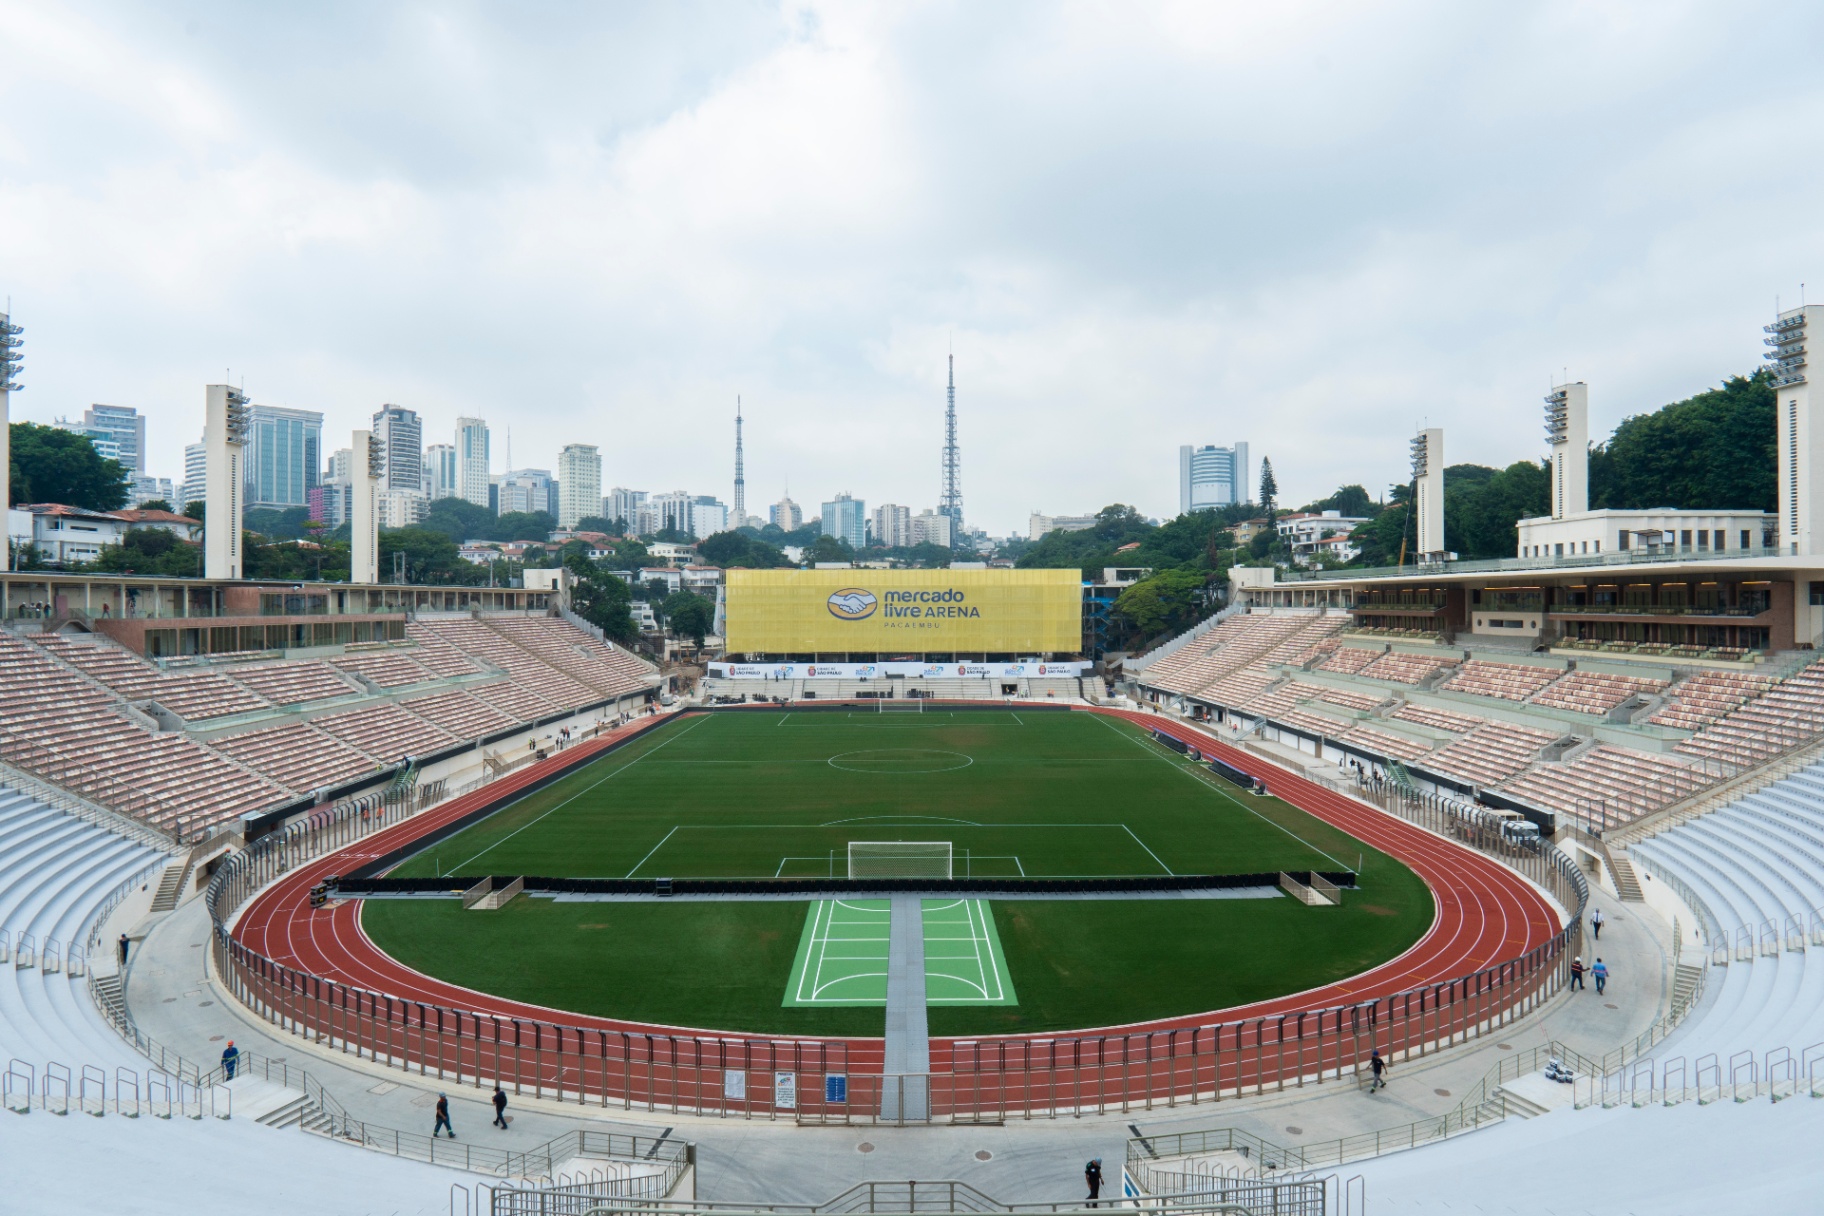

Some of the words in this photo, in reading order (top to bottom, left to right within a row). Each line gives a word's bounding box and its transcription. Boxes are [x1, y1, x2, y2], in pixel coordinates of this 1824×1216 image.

[884, 588, 965, 603] mercado
[884, 603, 922, 618] livre
[924, 607, 981, 618] ARENA
